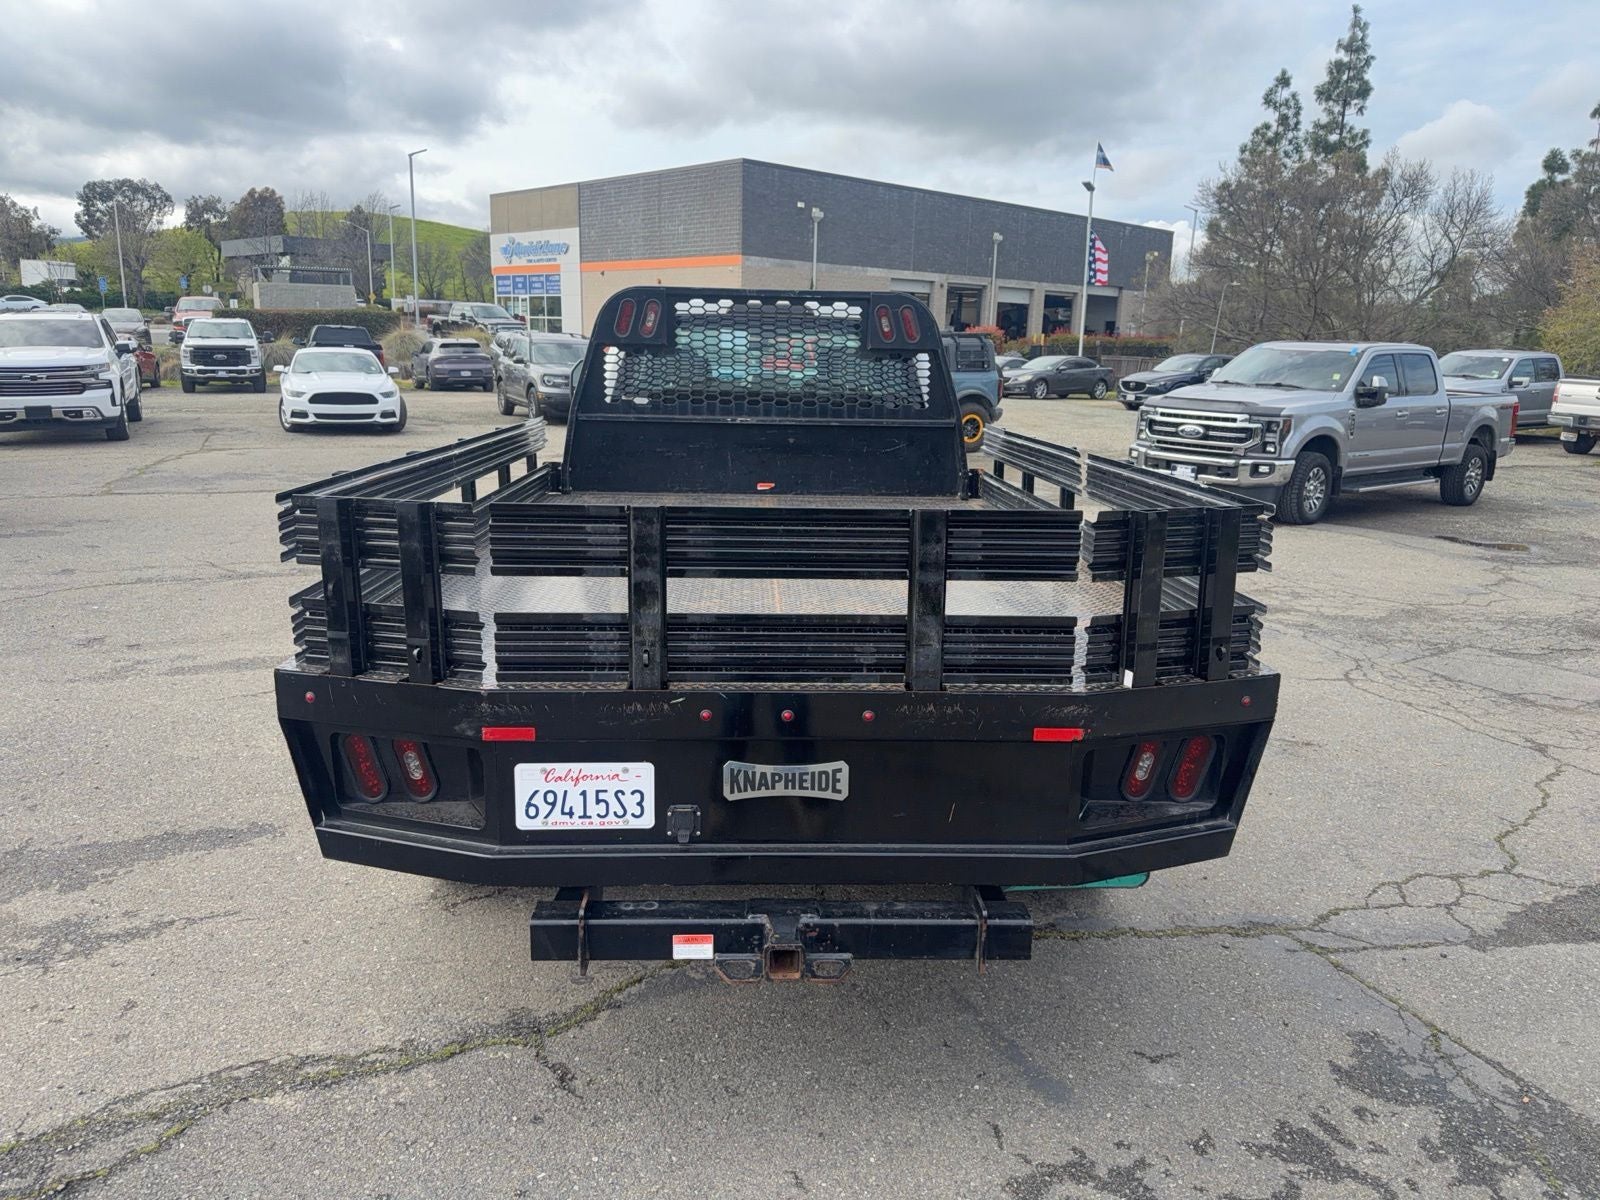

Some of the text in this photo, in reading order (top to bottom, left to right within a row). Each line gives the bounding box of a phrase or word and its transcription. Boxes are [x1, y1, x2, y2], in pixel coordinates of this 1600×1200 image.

[544, 767, 629, 787] California
[729, 767, 843, 795] KNAPHEIDE
[524, 789, 645, 819] 69415S3
